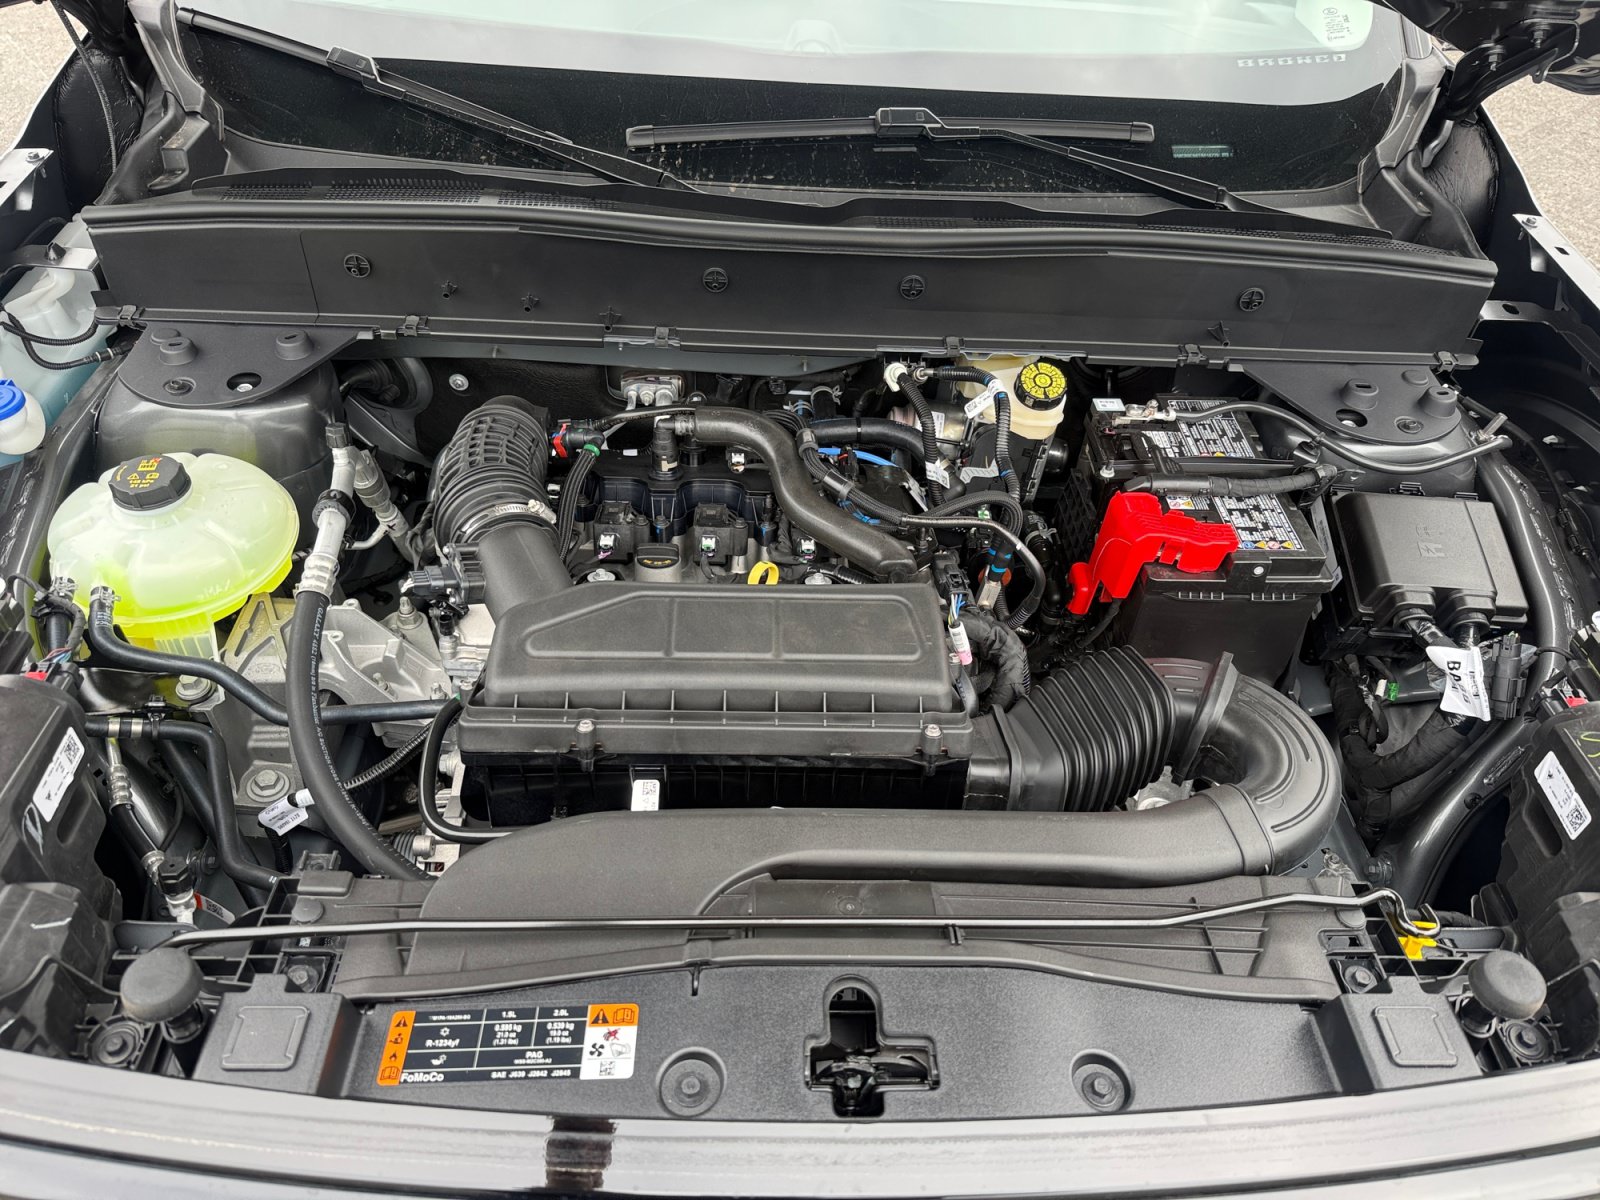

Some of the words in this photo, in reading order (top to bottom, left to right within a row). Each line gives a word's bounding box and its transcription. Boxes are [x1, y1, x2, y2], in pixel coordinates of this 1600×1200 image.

[1237, 53, 1347, 67] BRONCO
[312, 608, 324, 639] GALAXY
[319, 737, 332, 764] SUCTION
[328, 764, 340, 782] HOSE
[513, 1023, 522, 1032] kg
[565, 1022, 575, 1031] kg
[425, 1038, 460, 1048] R-1234yf
[525, 1051, 543, 1059] PAG
[400, 1072, 444, 1083] FoMoCo
[491, 1071, 506, 1079] SAE
